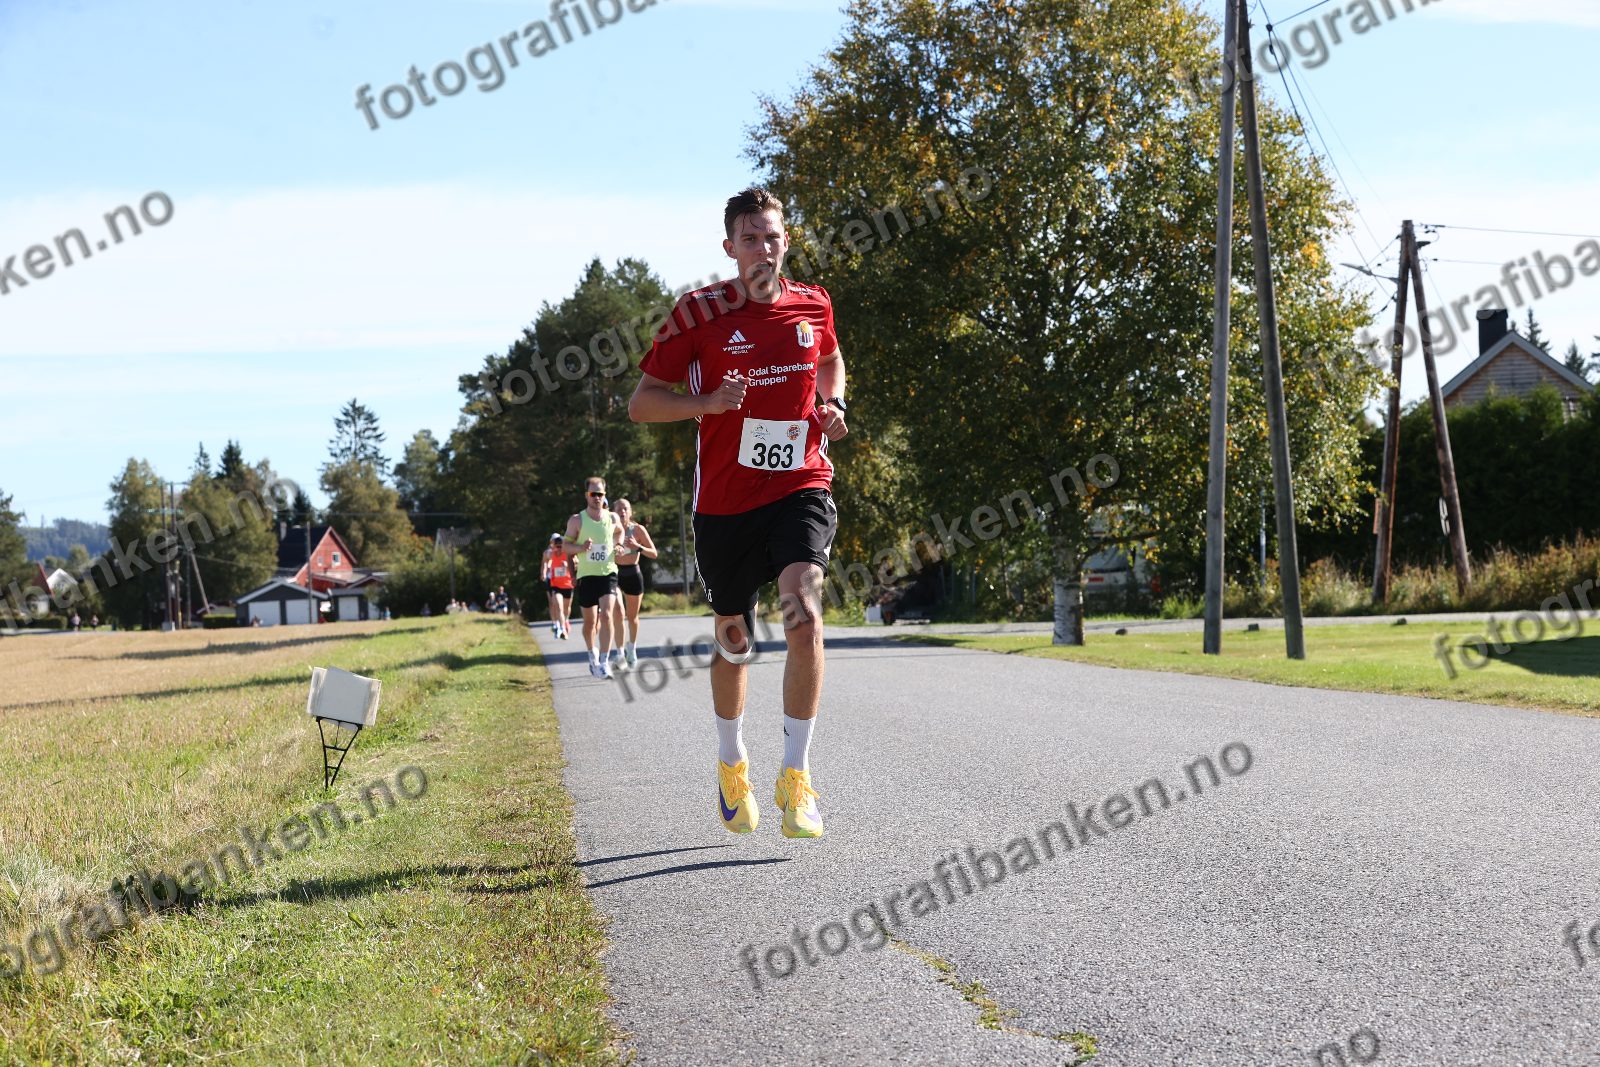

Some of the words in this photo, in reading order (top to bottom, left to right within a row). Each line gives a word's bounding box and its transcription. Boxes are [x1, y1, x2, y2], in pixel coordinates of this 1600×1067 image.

[748, 366, 769, 377] Odal
[770, 361, 815, 374] Sparebank
[748, 375, 787, 387] Gruppen
[751, 442, 794, 469] 363
[590, 551, 606, 561] 406
